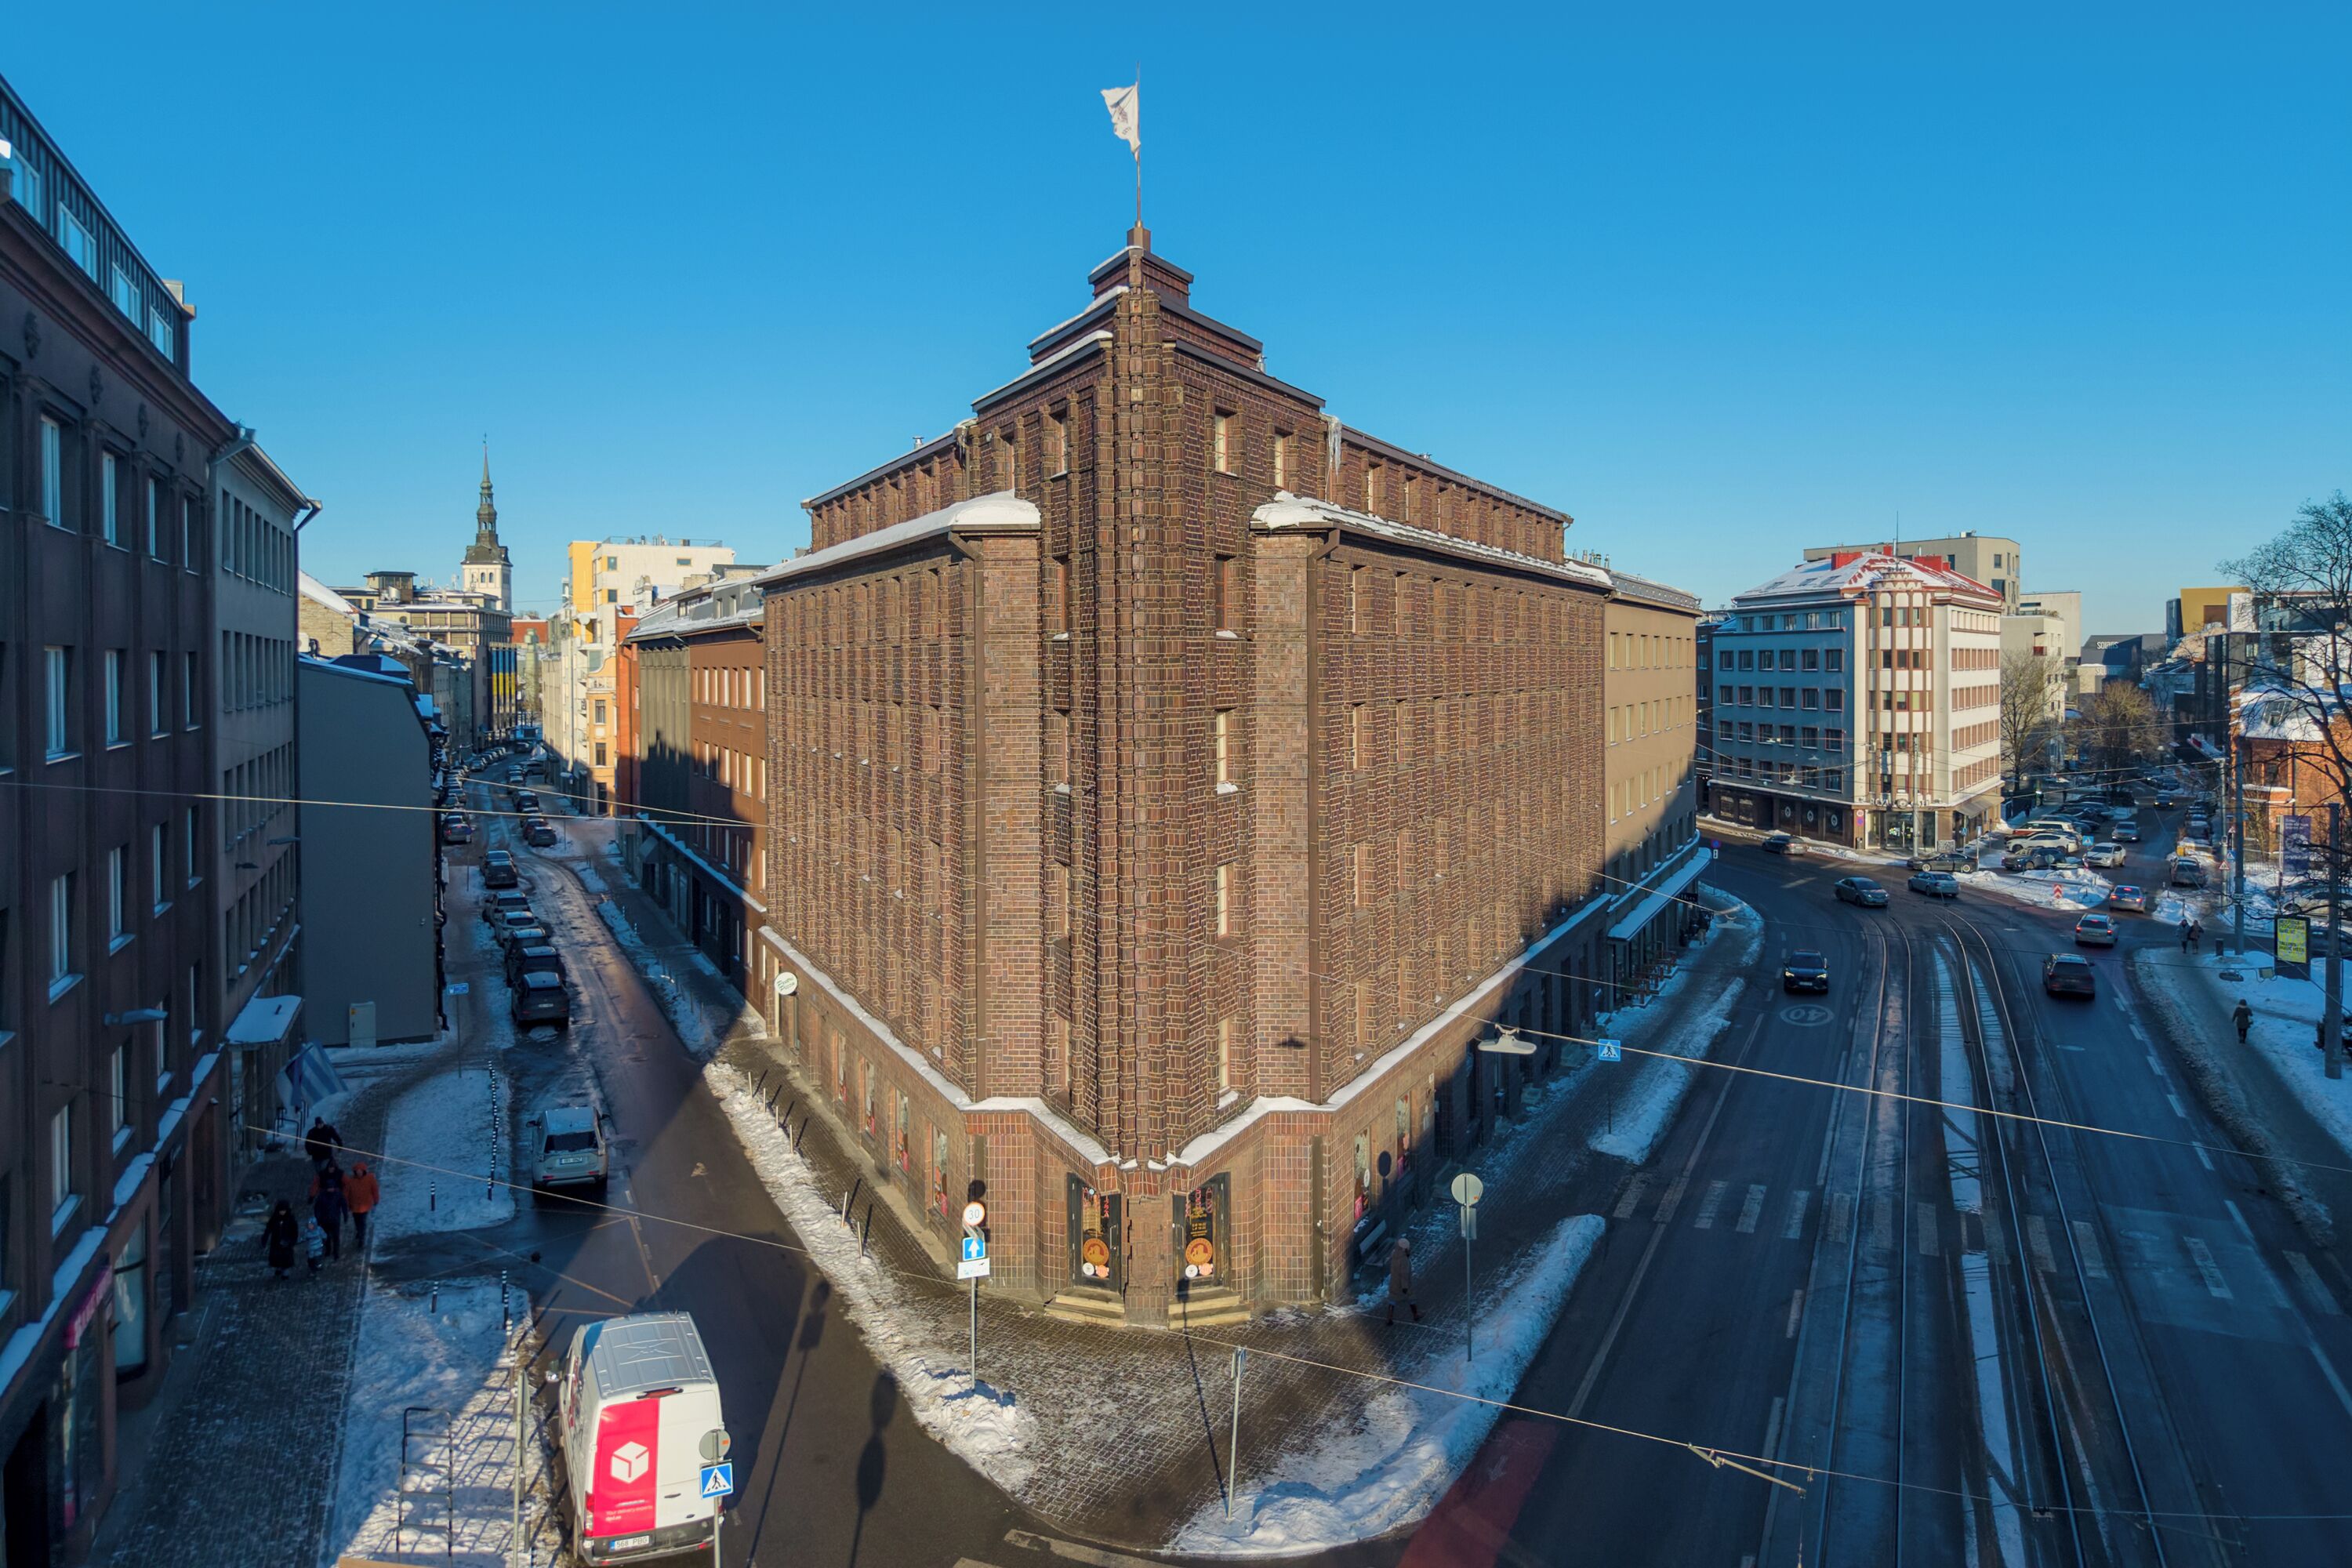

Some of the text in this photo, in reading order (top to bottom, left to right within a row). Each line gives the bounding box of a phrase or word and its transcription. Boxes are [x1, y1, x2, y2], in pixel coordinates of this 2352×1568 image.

[1790, 1008, 1826, 1021] 40
[968, 1209, 980, 1219] 30
[616, 1536, 648, 1548] 568 PBG
